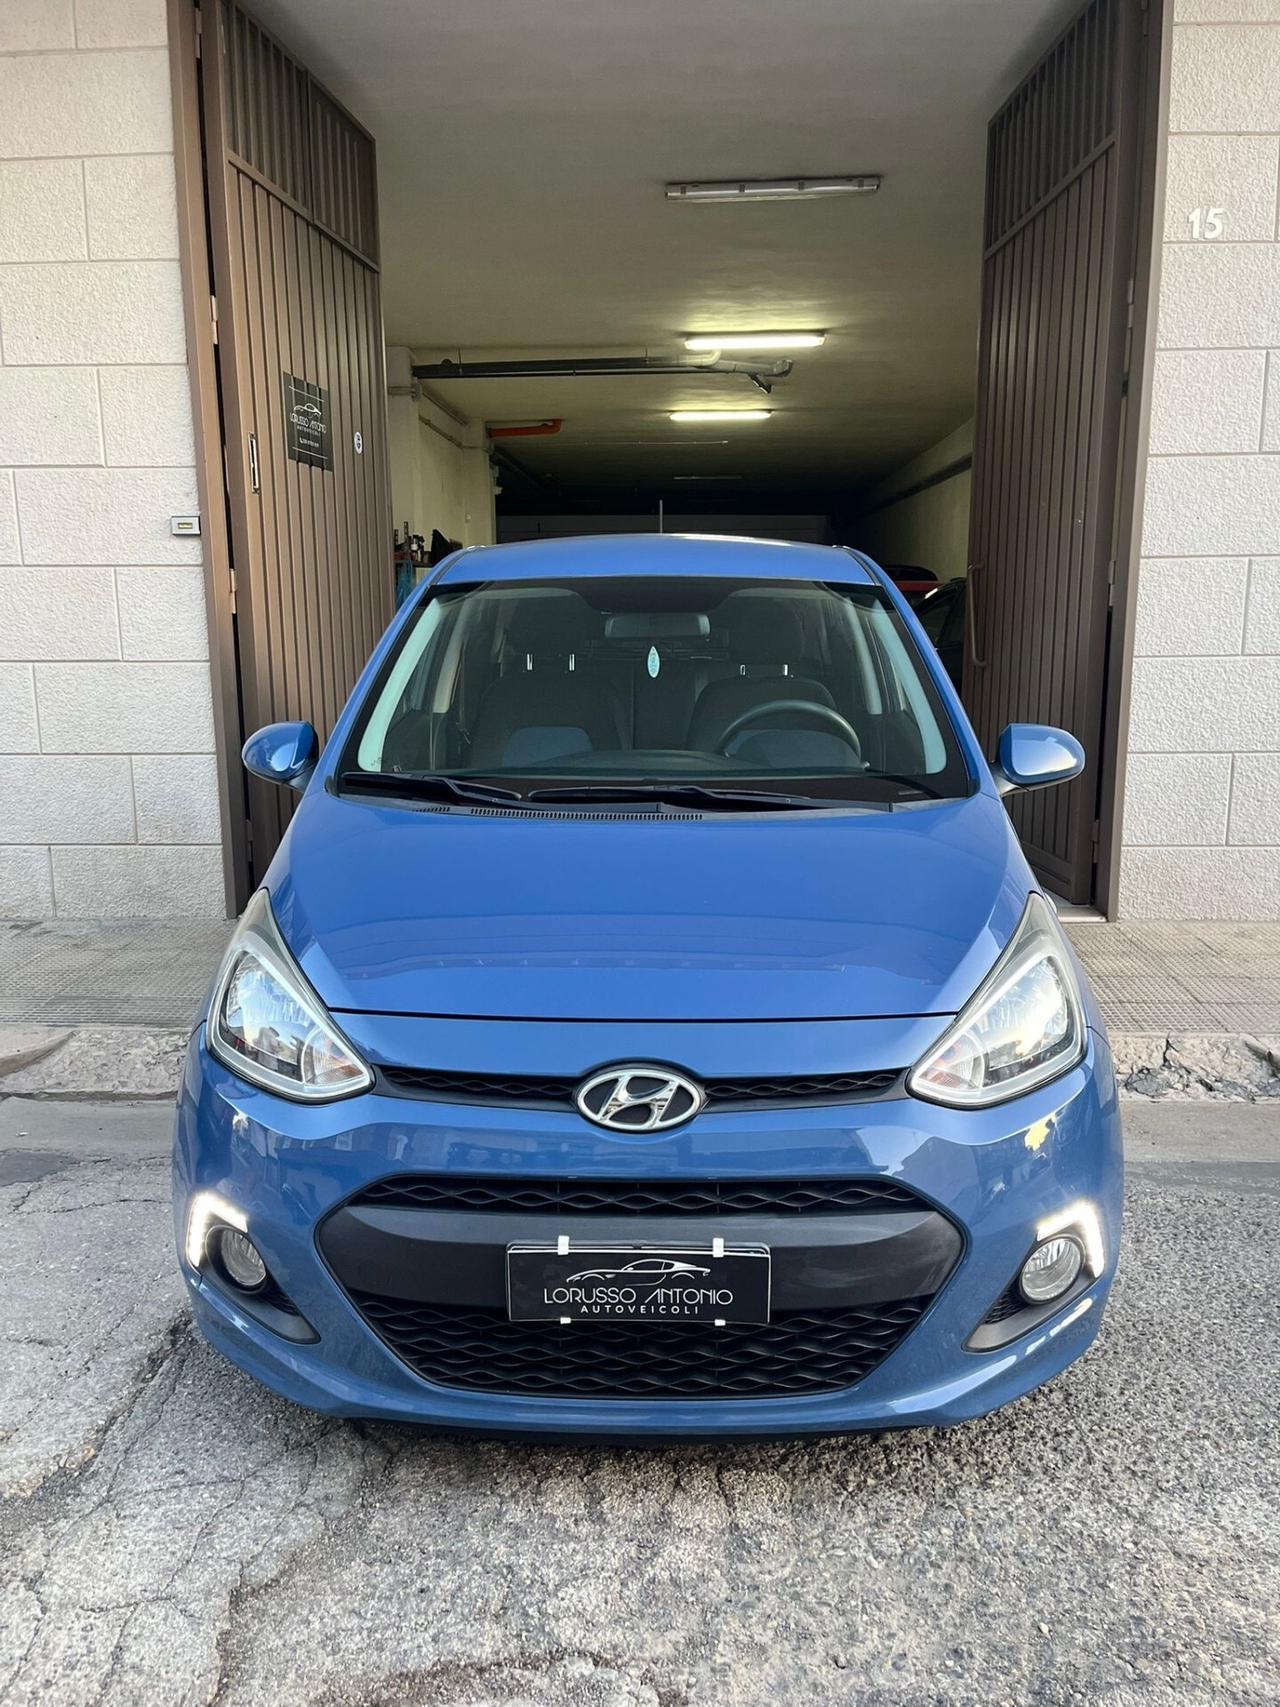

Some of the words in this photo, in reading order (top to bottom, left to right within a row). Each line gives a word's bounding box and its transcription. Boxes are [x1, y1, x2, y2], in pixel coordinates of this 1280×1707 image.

[1188, 207, 1225, 239] 15
[543, 1287, 636, 1303] LORUSSO
[644, 1288, 733, 1305] ANTONIO
[580, 1305, 698, 1314] AUTOVEICOLI
